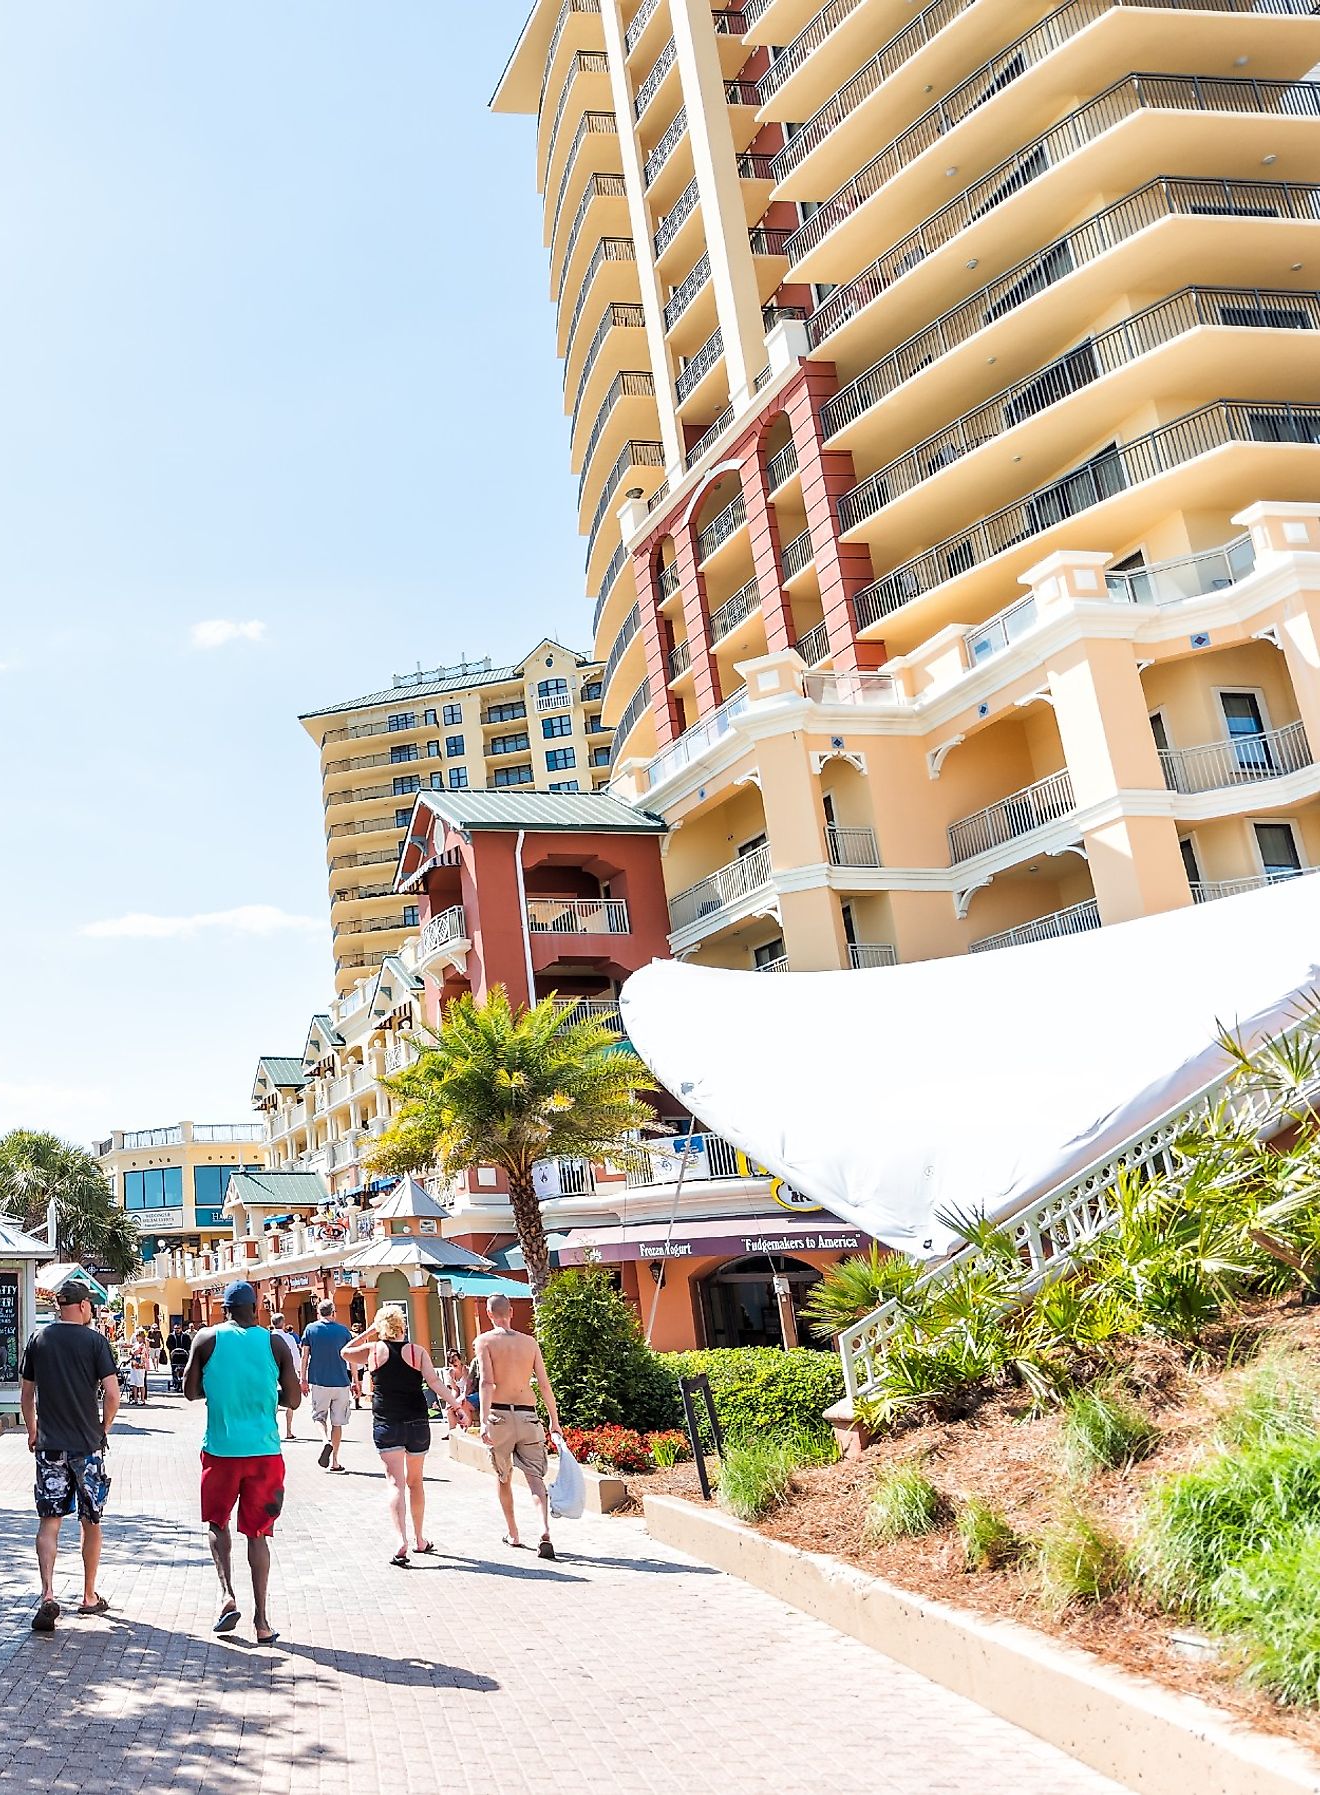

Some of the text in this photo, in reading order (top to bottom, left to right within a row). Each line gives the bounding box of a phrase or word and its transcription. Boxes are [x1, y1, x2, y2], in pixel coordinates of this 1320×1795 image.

[741, 1234, 860, 1253] "Fudgemakers to America"
